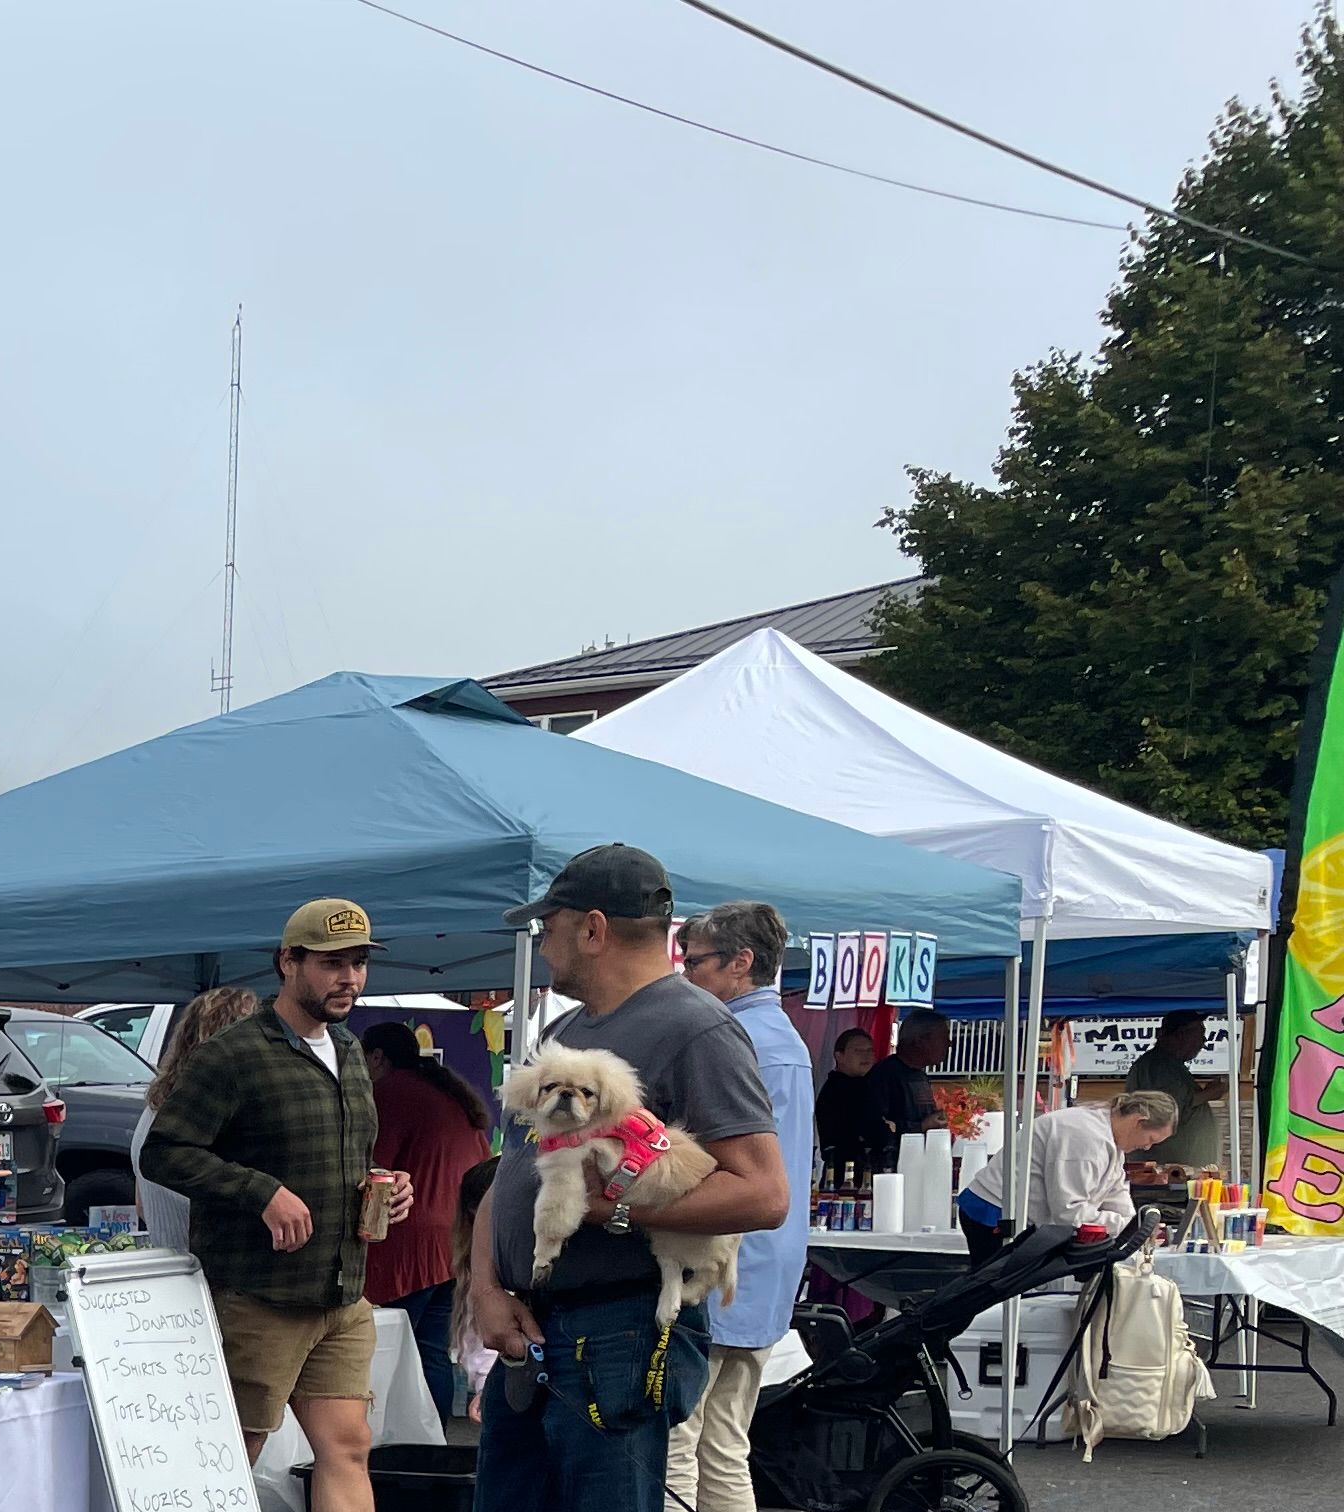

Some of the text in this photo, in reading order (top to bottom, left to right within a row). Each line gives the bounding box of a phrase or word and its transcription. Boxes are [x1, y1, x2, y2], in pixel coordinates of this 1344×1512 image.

[813, 945, 932, 995] BOOKS
[77, 1288, 152, 1314] SUGGESTED
[125, 1308, 205, 1333] DONATIONS
[95, 1356, 168, 1382] T-SHIRTS
[105, 1391, 221, 1431] TOTE BAGS $15
[115, 1435, 235, 1474] HATS $20
